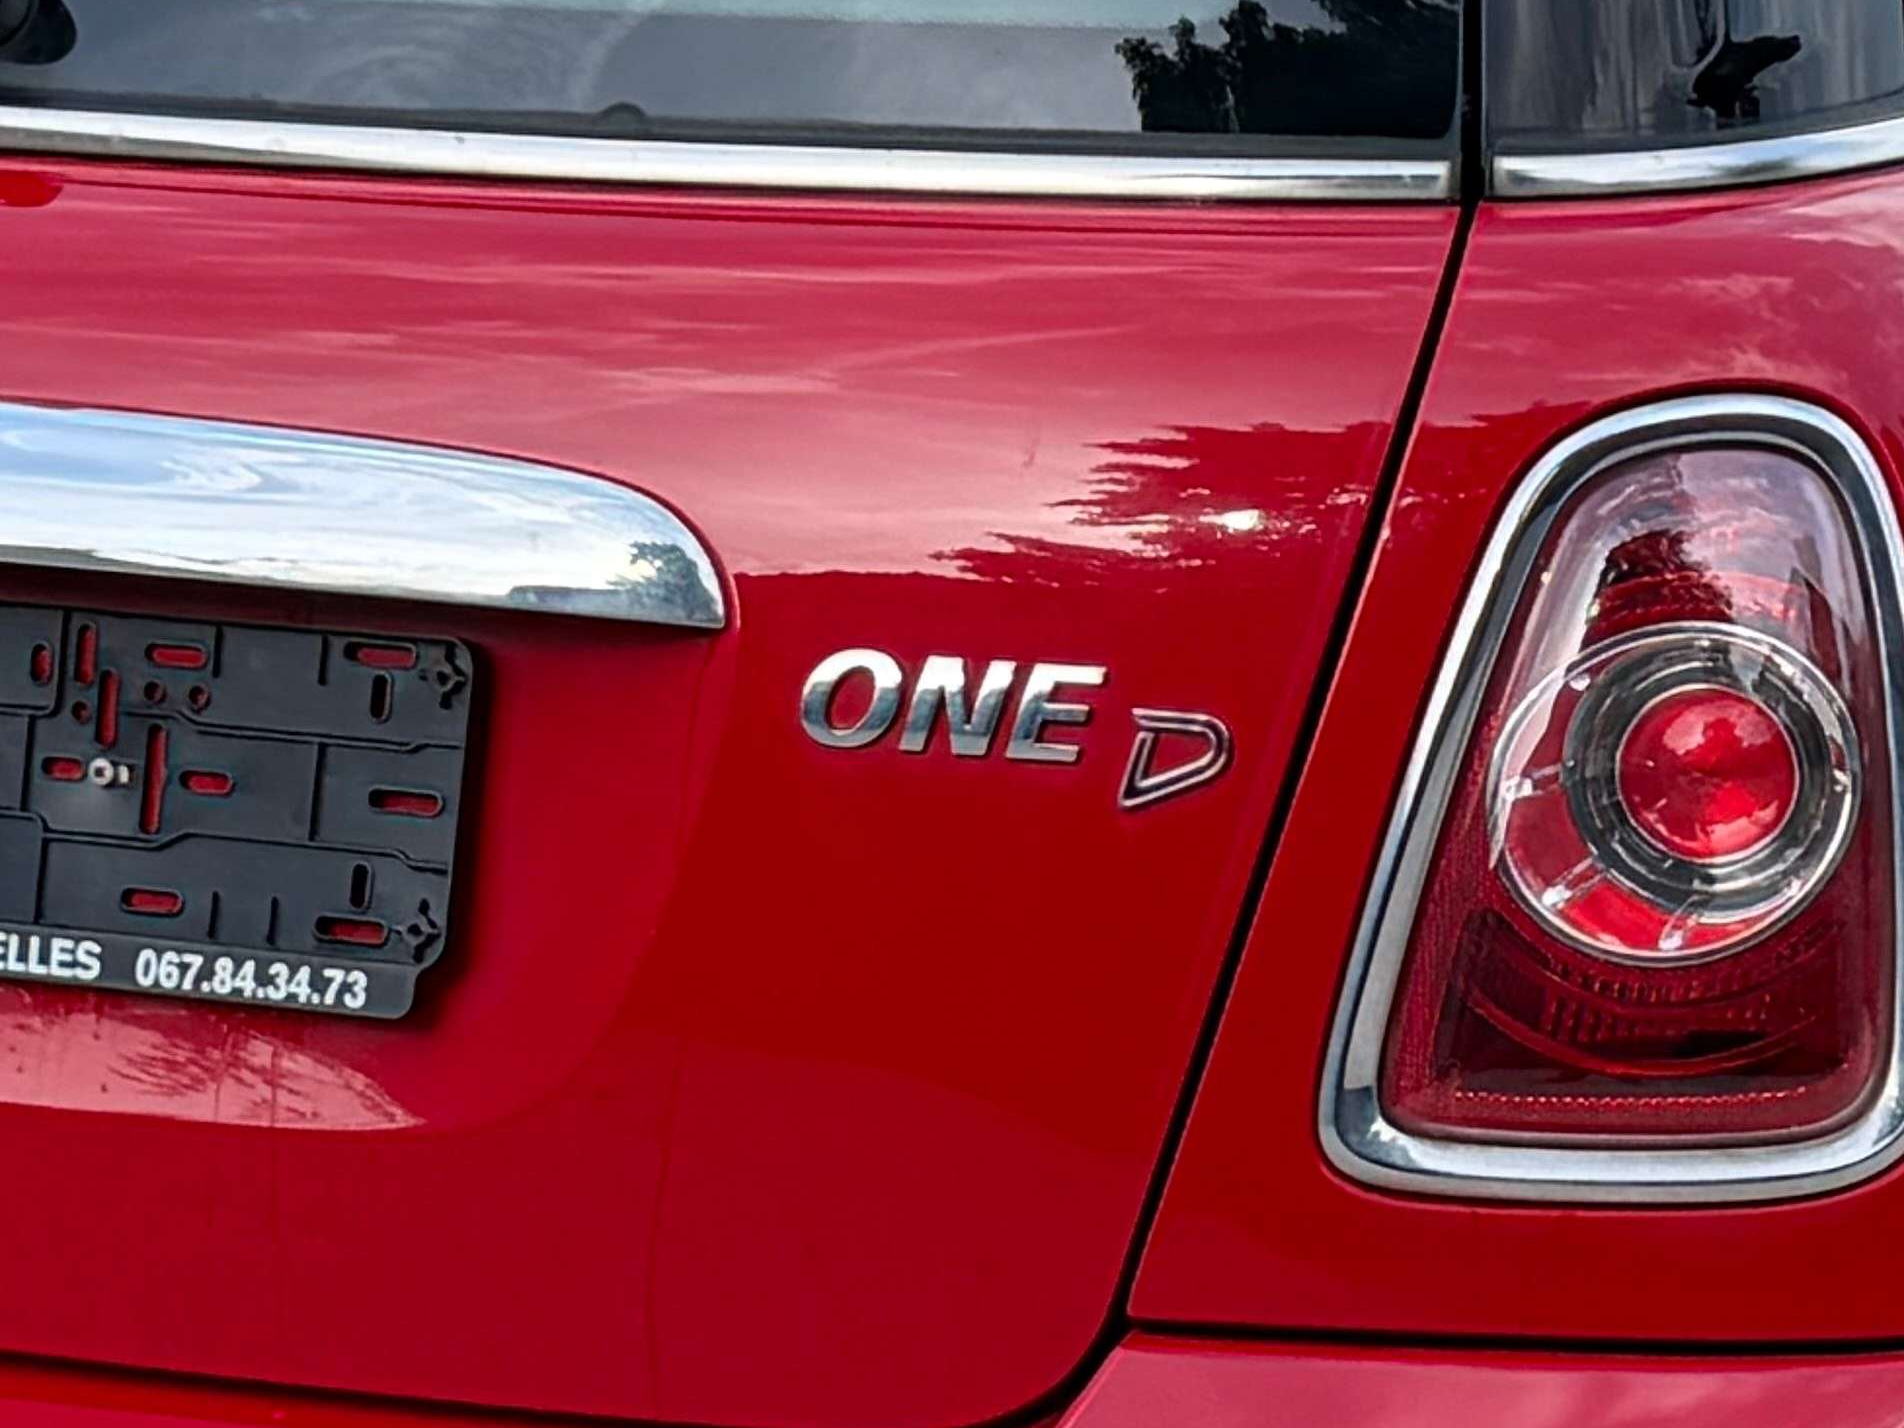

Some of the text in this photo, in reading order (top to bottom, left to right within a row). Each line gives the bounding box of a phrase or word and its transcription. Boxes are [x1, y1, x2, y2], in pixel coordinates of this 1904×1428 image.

[800, 647, 1234, 809] ONE D
[134, 947, 370, 1010] 067.84.34.73
